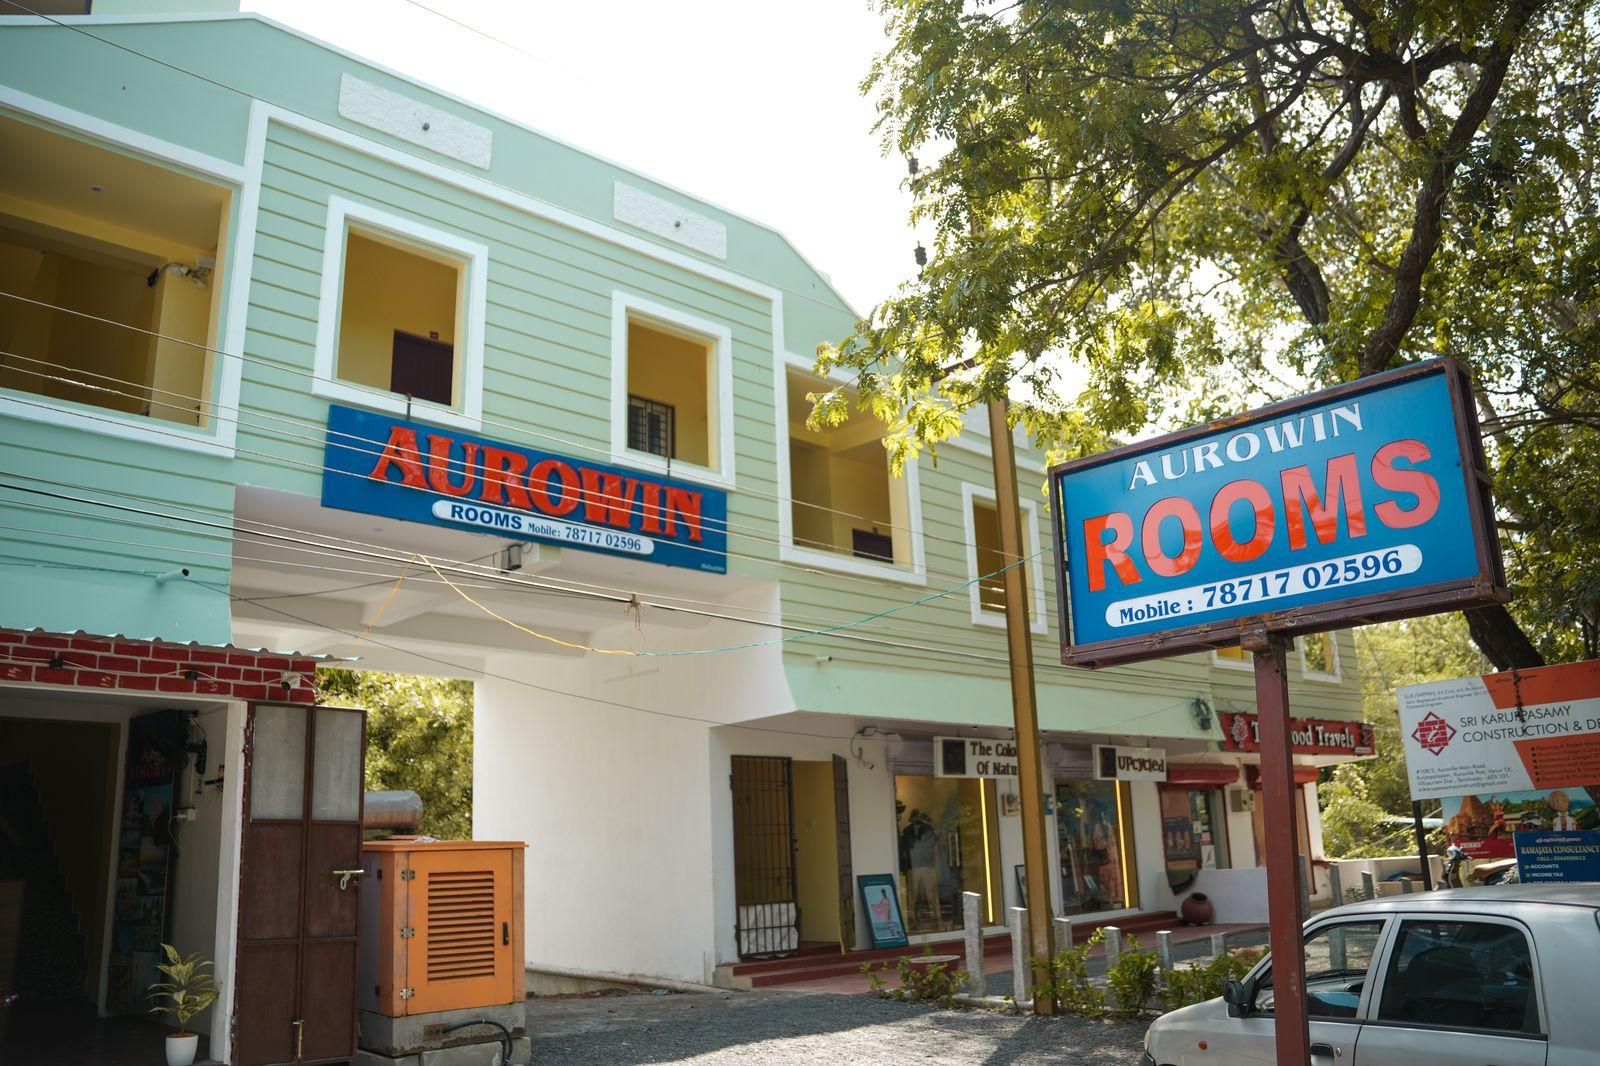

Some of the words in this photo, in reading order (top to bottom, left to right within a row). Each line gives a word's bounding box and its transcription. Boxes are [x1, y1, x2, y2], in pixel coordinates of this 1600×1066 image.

[1128, 402, 1364, 491] AUROWIN
[368, 426, 704, 542] AUROWIN
[1082, 438, 1441, 593] ROOMS
[451, 504, 522, 530] ROOMS
[565, 526, 602, 545] 78717
[605, 534, 642, 551] 02596
[1203, 572, 1290, 609] 78717
[1302, 550, 1403, 590] 02596
[1460, 716, 1477, 728] SRI
[1463, 721, 1569, 743] CONSTRUCTION
[1573, 720, 1583, 731] &
[1315, 725, 1355, 748] Travels
[970, 741, 992, 756] The
[995, 743, 1016, 757] Colo
[976, 761, 990, 775] Of
[993, 762, 1017, 776] Natu
[1553, 845, 1600, 854] CONSULTANCY
